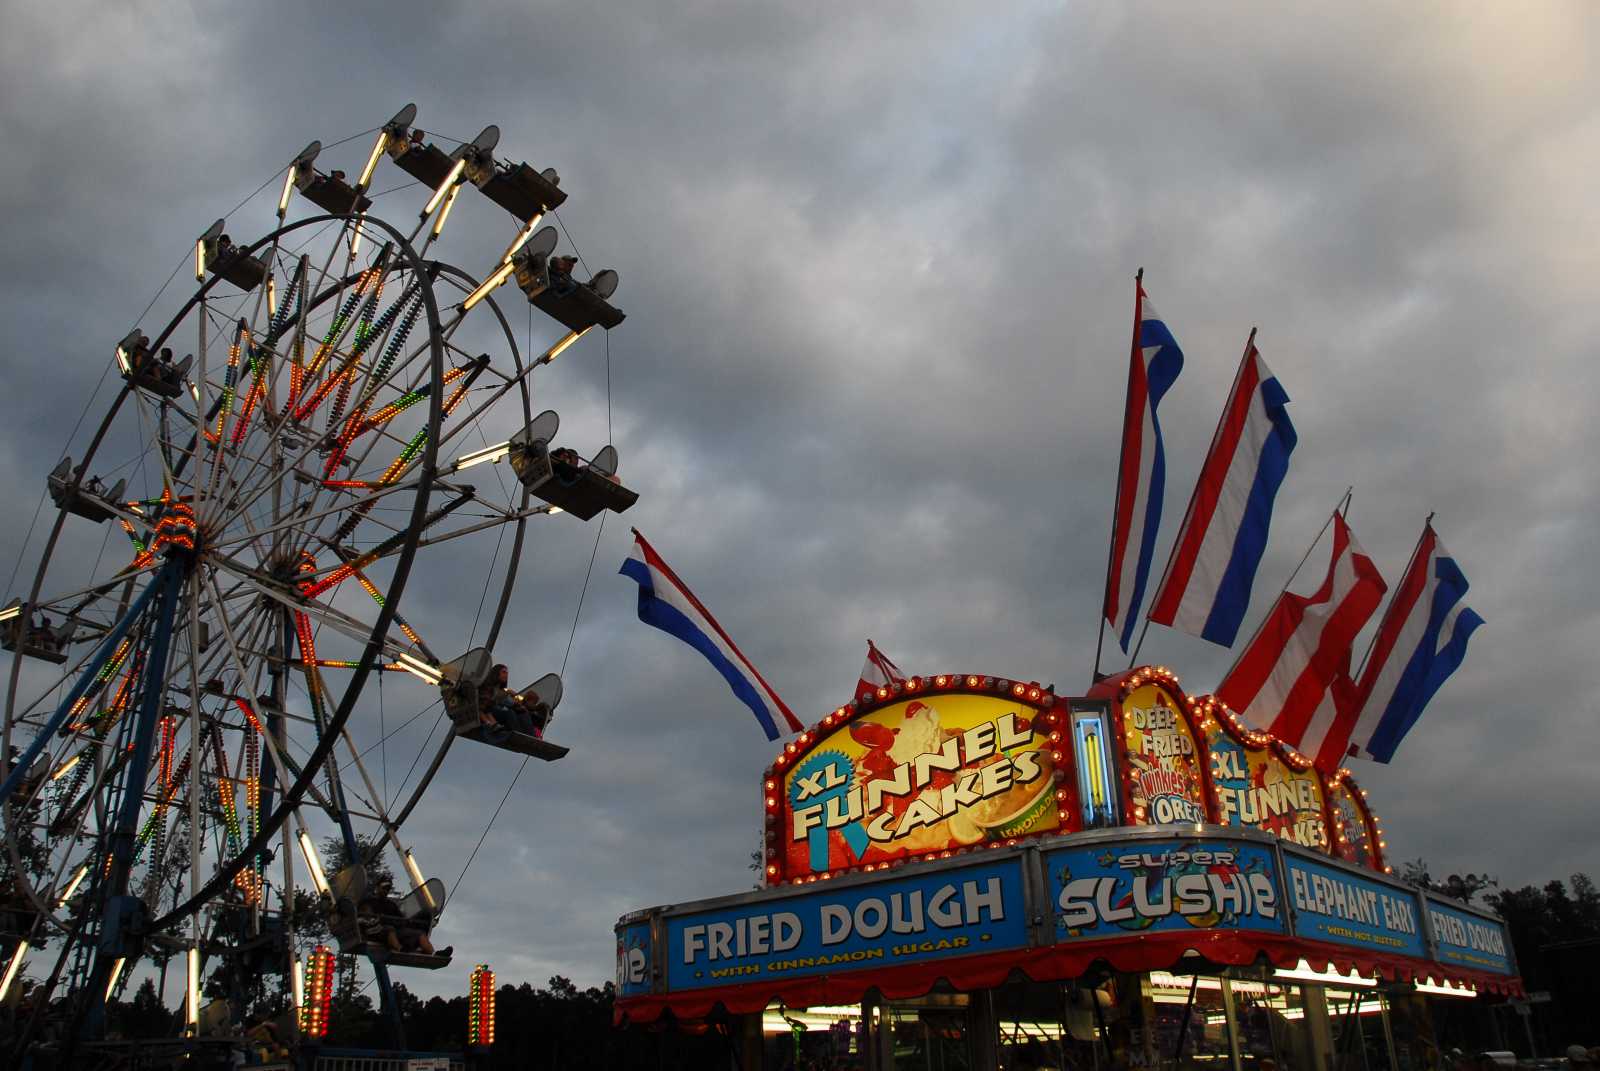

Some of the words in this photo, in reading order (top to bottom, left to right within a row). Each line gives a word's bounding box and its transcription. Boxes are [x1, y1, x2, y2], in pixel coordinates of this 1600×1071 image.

[1132, 705, 1177, 730] DEEP
[1142, 734, 1193, 758] FRIED
[1216, 751, 1246, 779] XL
[793, 712, 1033, 840] FUNNEL
[796, 762, 848, 800] XL
[866, 751, 1041, 842] CAKES
[1218, 779, 1321, 825] FUNNEL
[1291, 867, 1379, 927] ELEPHANT
[684, 912, 803, 964] FRIED
[820, 877, 1005, 945] DOUGH
[1430, 911, 1467, 947] FRIED
[1467, 921, 1507, 957] DOUGH
[711, 964, 761, 979] WITH
[767, 948, 884, 973] CINNAMON
[892, 935, 970, 957] SUGAR
